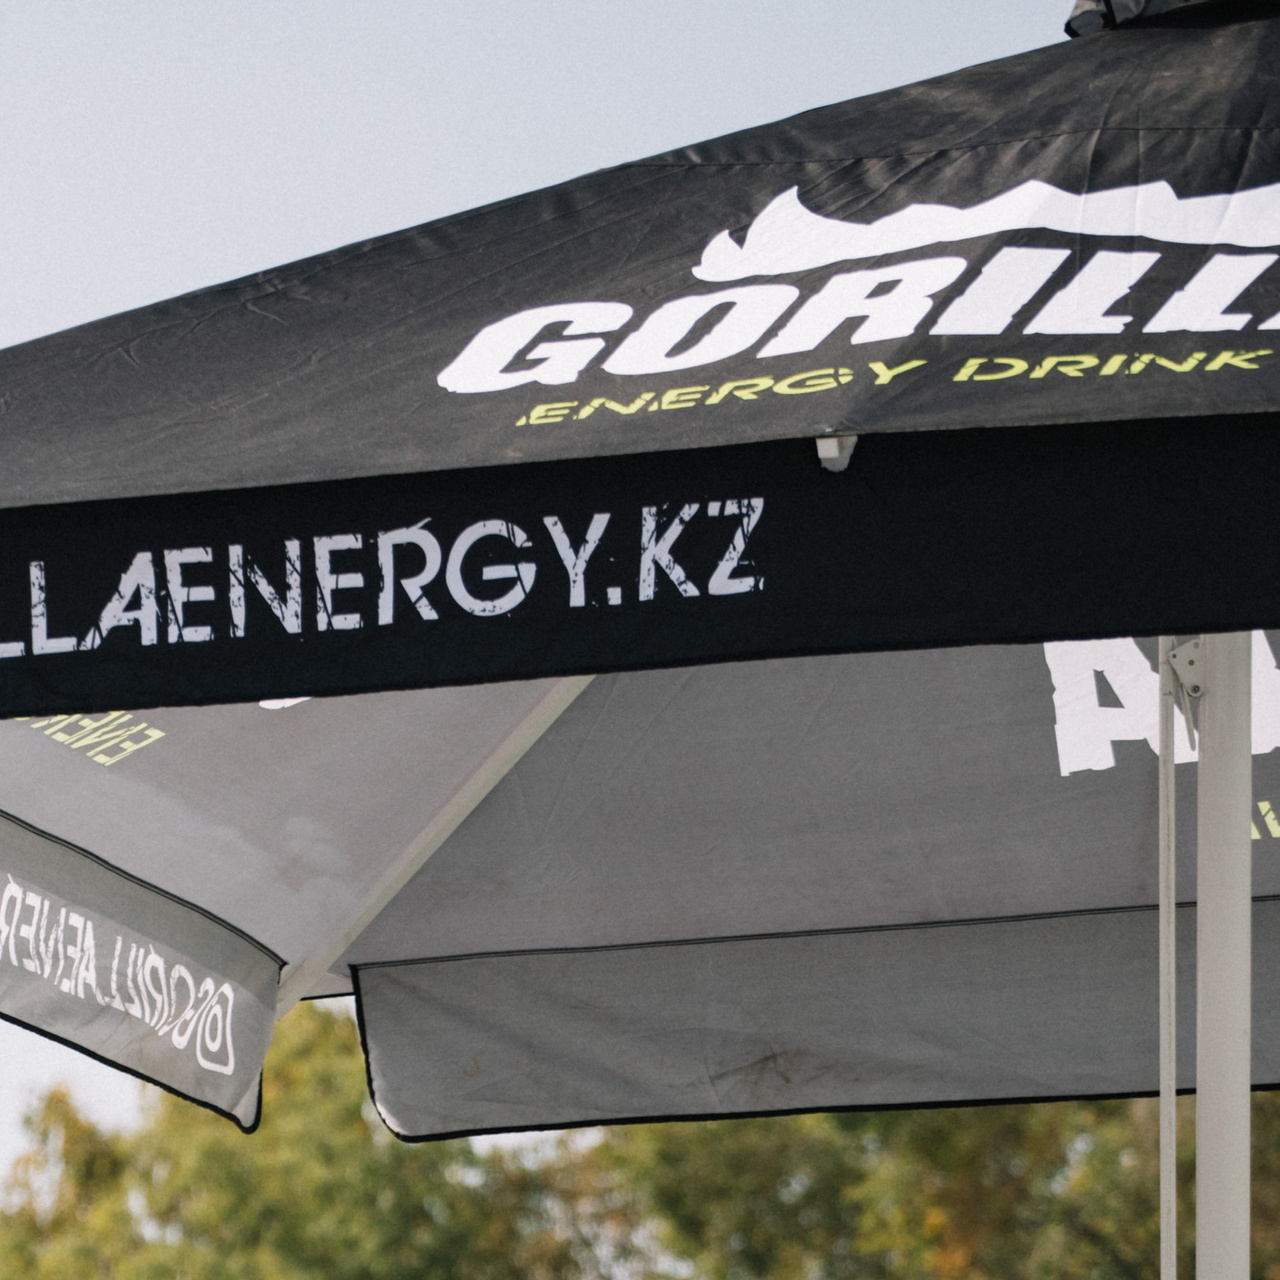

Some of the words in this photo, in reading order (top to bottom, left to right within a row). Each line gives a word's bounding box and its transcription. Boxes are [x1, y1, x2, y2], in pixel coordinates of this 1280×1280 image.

[436, 245, 1280, 394] GORILL
[515, 358, 928, 427] ENERGY
[952, 348, 1275, 383] DRINK
